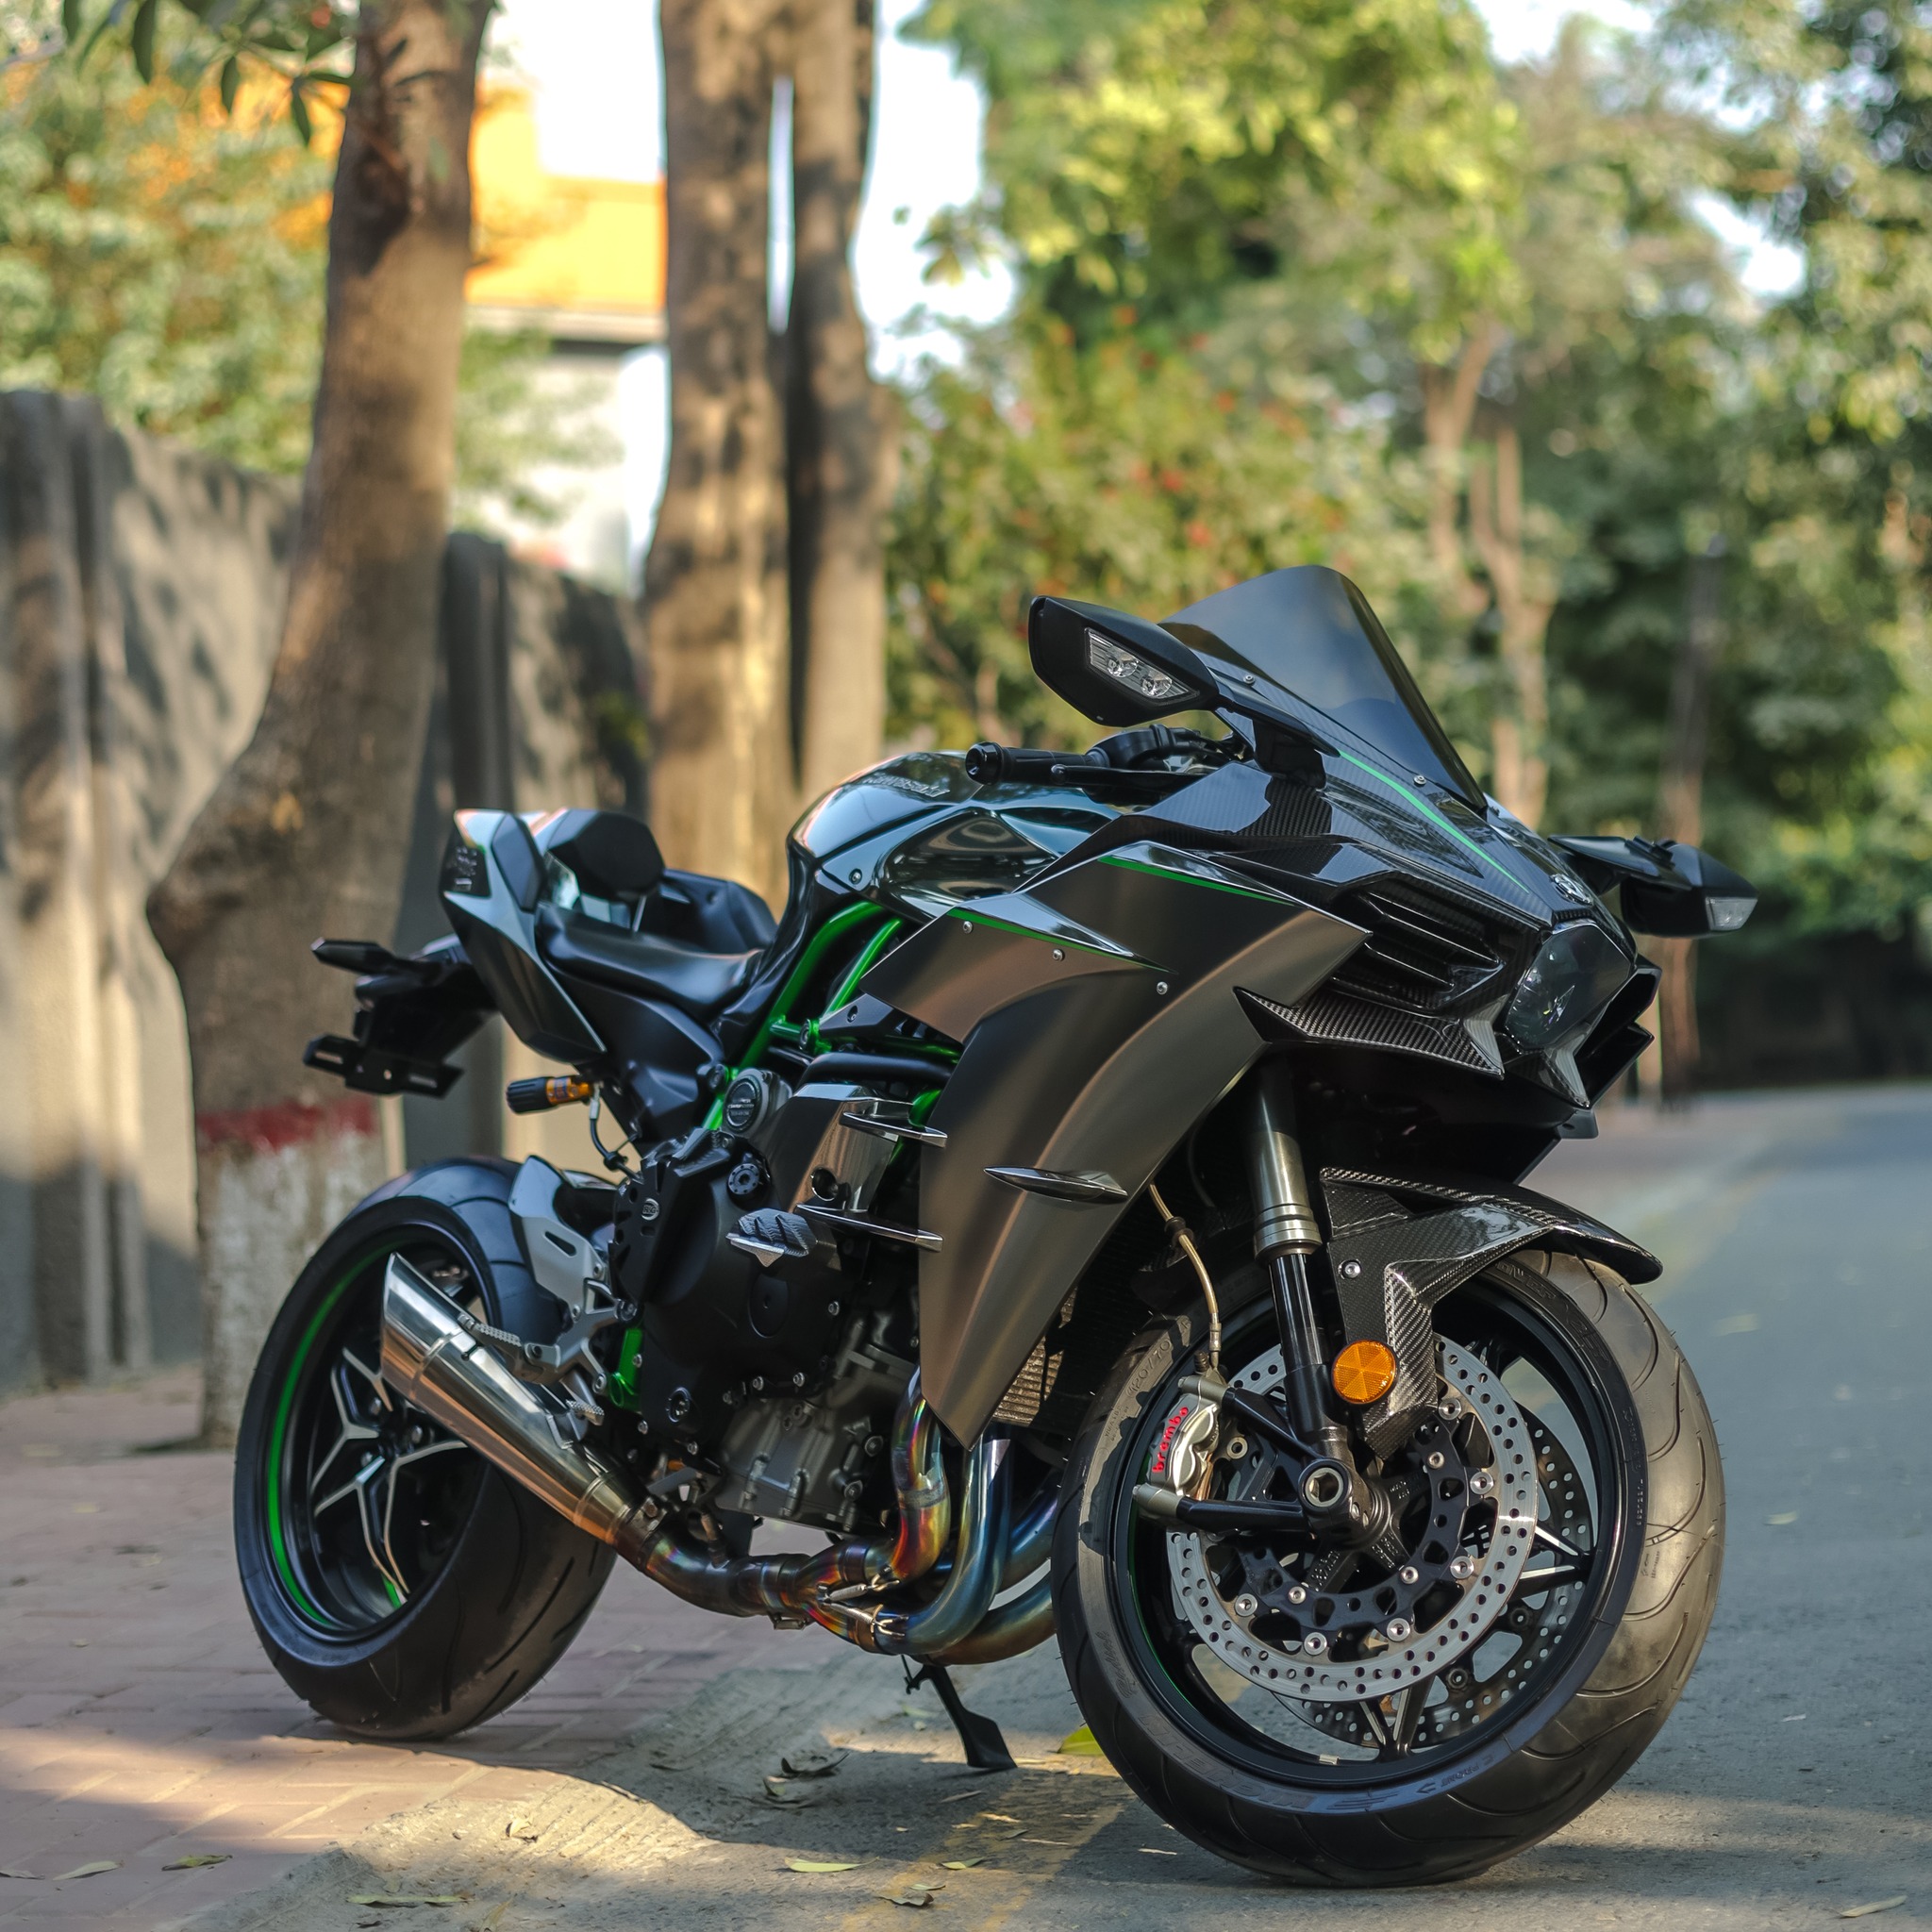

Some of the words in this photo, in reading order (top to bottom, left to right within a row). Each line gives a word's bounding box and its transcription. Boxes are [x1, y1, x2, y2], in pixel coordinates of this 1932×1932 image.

[863, 772, 950, 797] Kawasaki
[1498, 1262, 1557, 1300] OWER
[1129, 1341, 1170, 1391] 120/70
[1152, 1407, 1189, 1473] brembo
